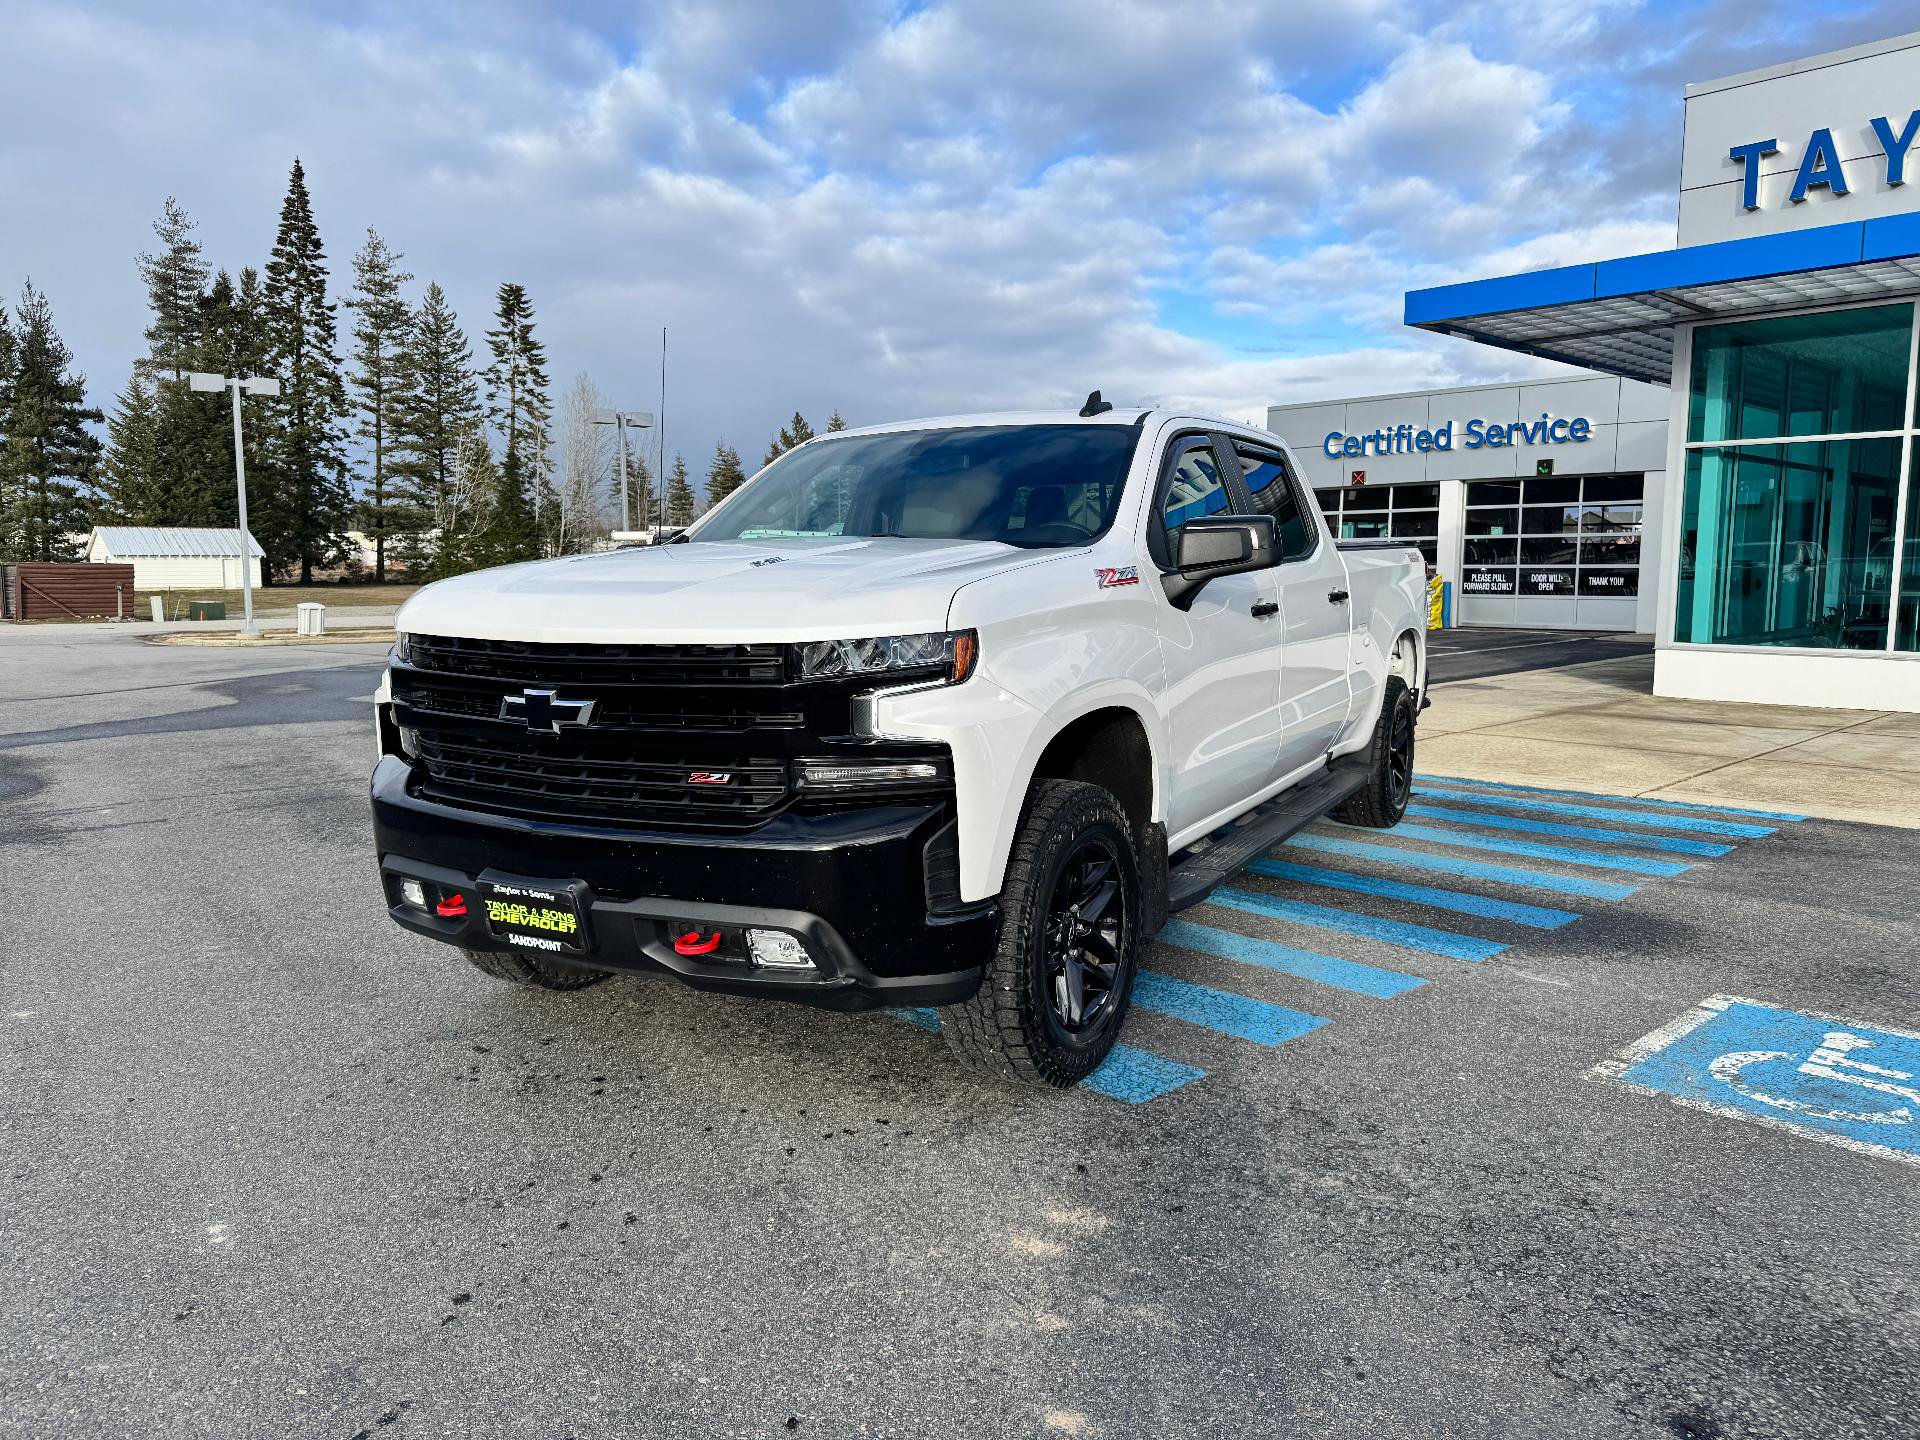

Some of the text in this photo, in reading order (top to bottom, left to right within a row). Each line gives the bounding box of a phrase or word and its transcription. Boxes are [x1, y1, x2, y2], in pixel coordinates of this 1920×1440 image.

[1323, 413, 1591, 459] Certified Service
[1471, 573, 1506, 583] PLEASE PULL
[1531, 574, 1563, 583] DOOR WILL
[1588, 576, 1625, 585] THANK YOU!
[1463, 582, 1513, 591] FORWARD SLOWLY
[1538, 582, 1554, 591] OPEN
[485, 900, 576, 922] TAYLOR & SONS
[490, 911, 577, 933] CHEVROLET
[508, 934, 561, 951] SANDPOINT
